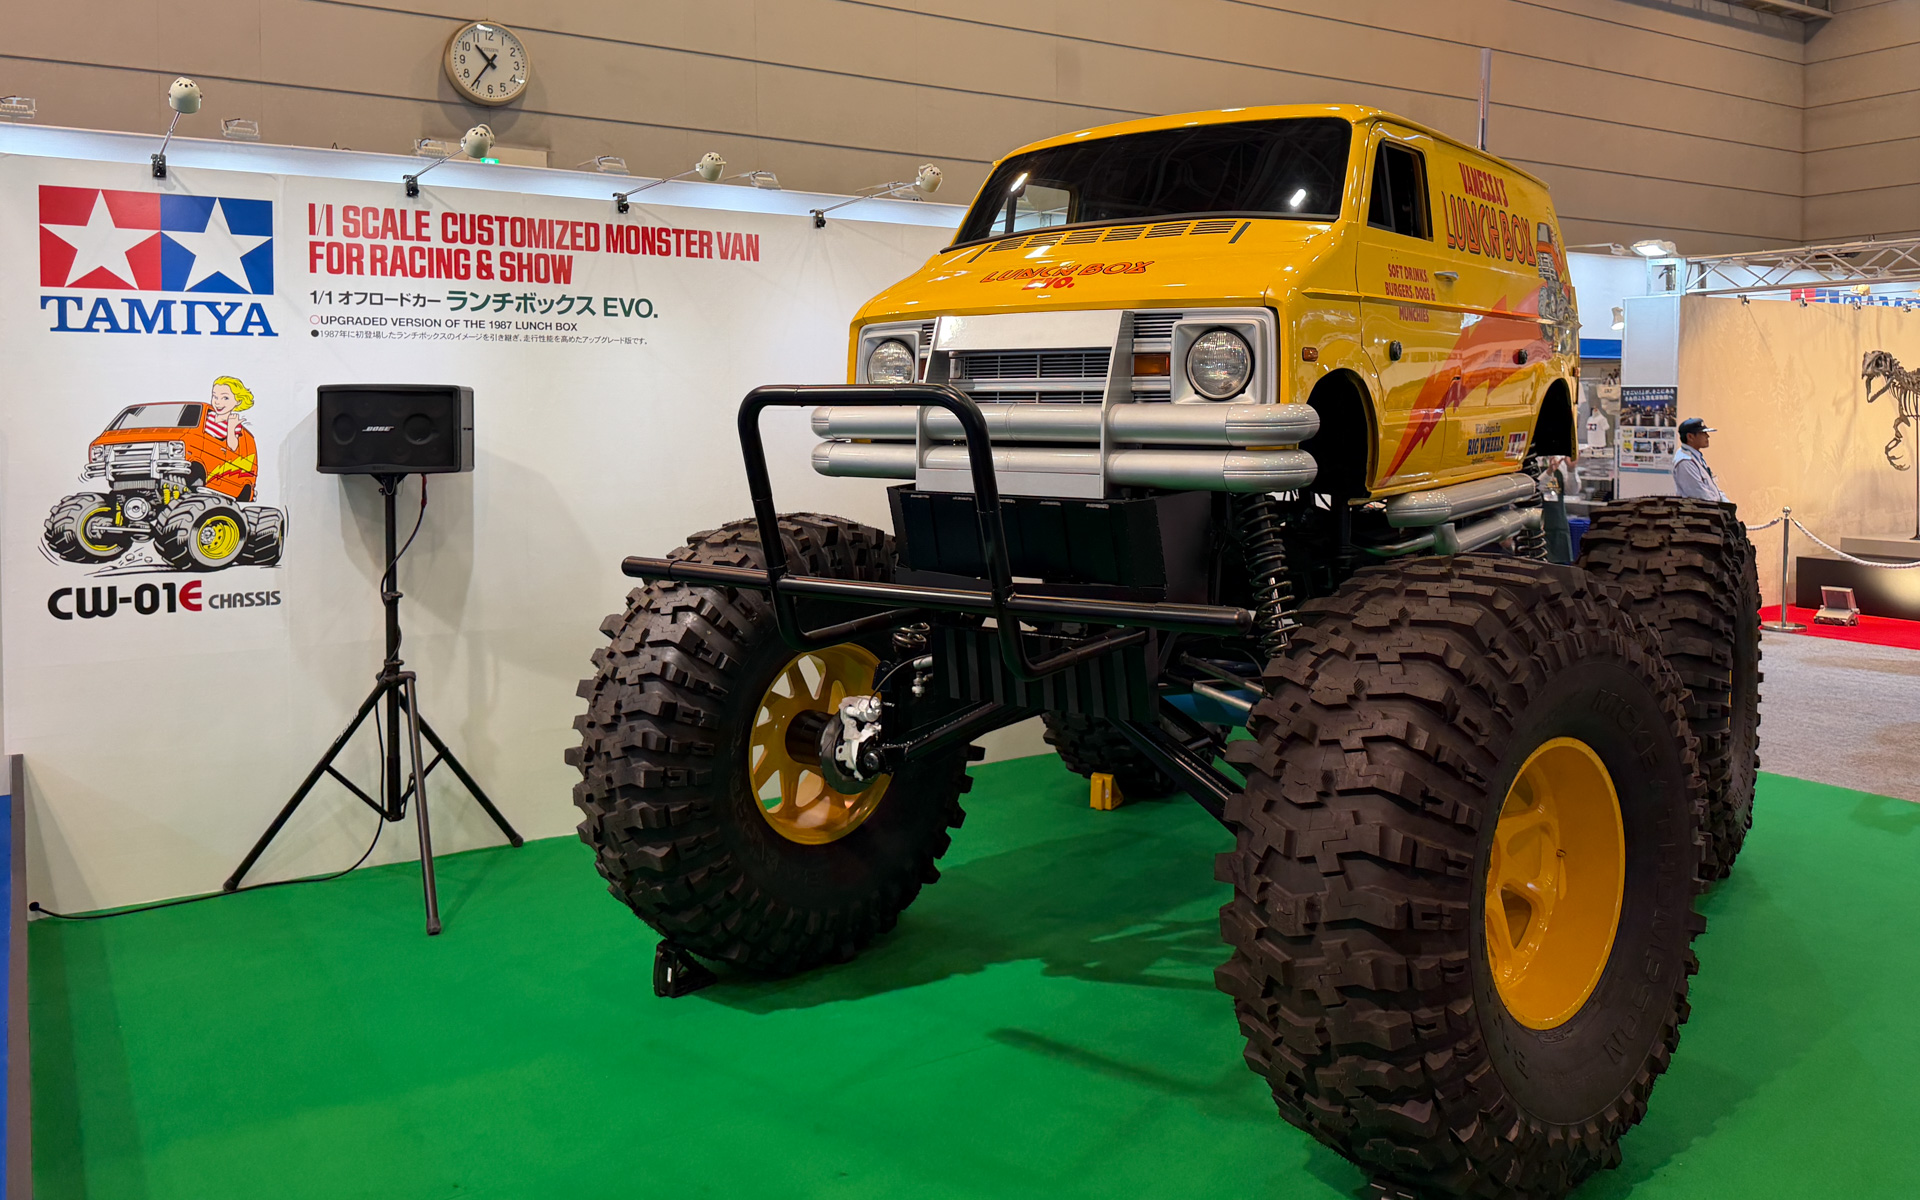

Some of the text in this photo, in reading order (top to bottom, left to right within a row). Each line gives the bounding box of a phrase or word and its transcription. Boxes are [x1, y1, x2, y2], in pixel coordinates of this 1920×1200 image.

[473, 33, 480, 42] 11
[485, 31, 494, 41] 12
[462, 41, 470, 51] 10
[510, 47, 516, 57] 2
[459, 54, 465, 64] 9
[513, 61, 519, 71] 3
[463, 68, 469, 78] 8
[488, 84, 493, 94] 6
[500, 82, 506, 92] 5
[1458, 162, 1509, 208] VANESSA'S
[342, 205, 431, 242] SCALE
[441, 211, 600, 252] CUSTOMIZED
[605, 223, 713, 259] MONSTER
[716, 231, 760, 262] VAN
[1441, 191, 1537, 267] LUNCH BOX
[309, 241, 573, 285] FOR RACING & SHOW
[1388, 263, 1403, 278] SOFT
[980, 260, 1155, 283] LUNCH BOX
[1415, 287, 1430, 301] DOGS
[309, 290, 659, 319] 1/1 オフロードカー ランチボックス EVO.
[40, 295, 279, 337] TAMIYA
[1398, 305, 1430, 323] MUNCHIES
[320, 315, 578, 332] UPGRADED VERSION OF THE 1987 LUNCH BOX
[1467, 438, 1480, 456] BIG
[1479, 435, 1505, 455] WHEELS
[47, 580, 282, 621] CW-01E CHASSIS
